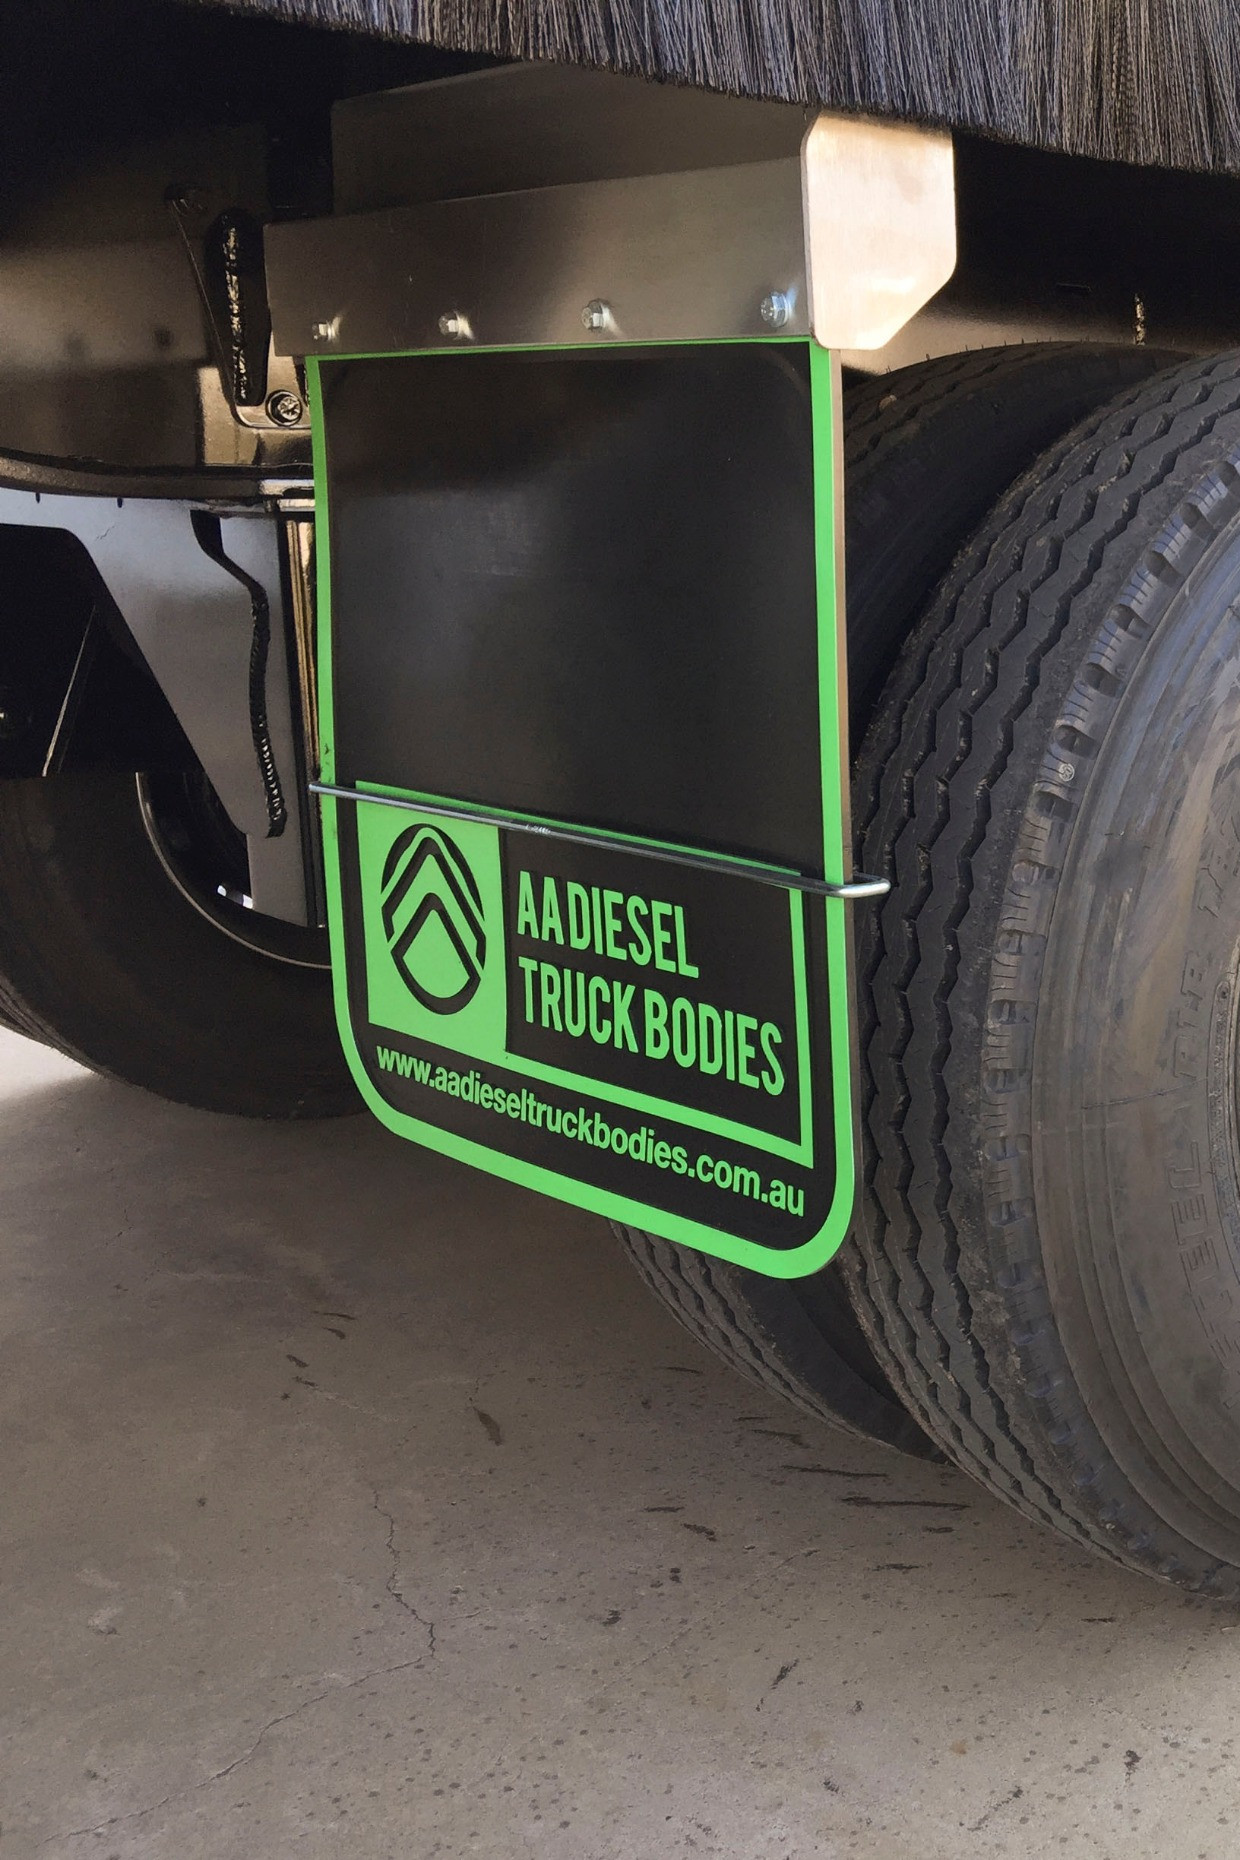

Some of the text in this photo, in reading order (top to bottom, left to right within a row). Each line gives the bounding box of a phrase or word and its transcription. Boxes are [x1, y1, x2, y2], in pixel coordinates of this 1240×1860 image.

[517, 870, 699, 979] AADIESEL
[518, 956, 784, 1096] TRUCK BODIES
[376, 1045, 805, 1217] www.aadieseltruckbodies.com.au
